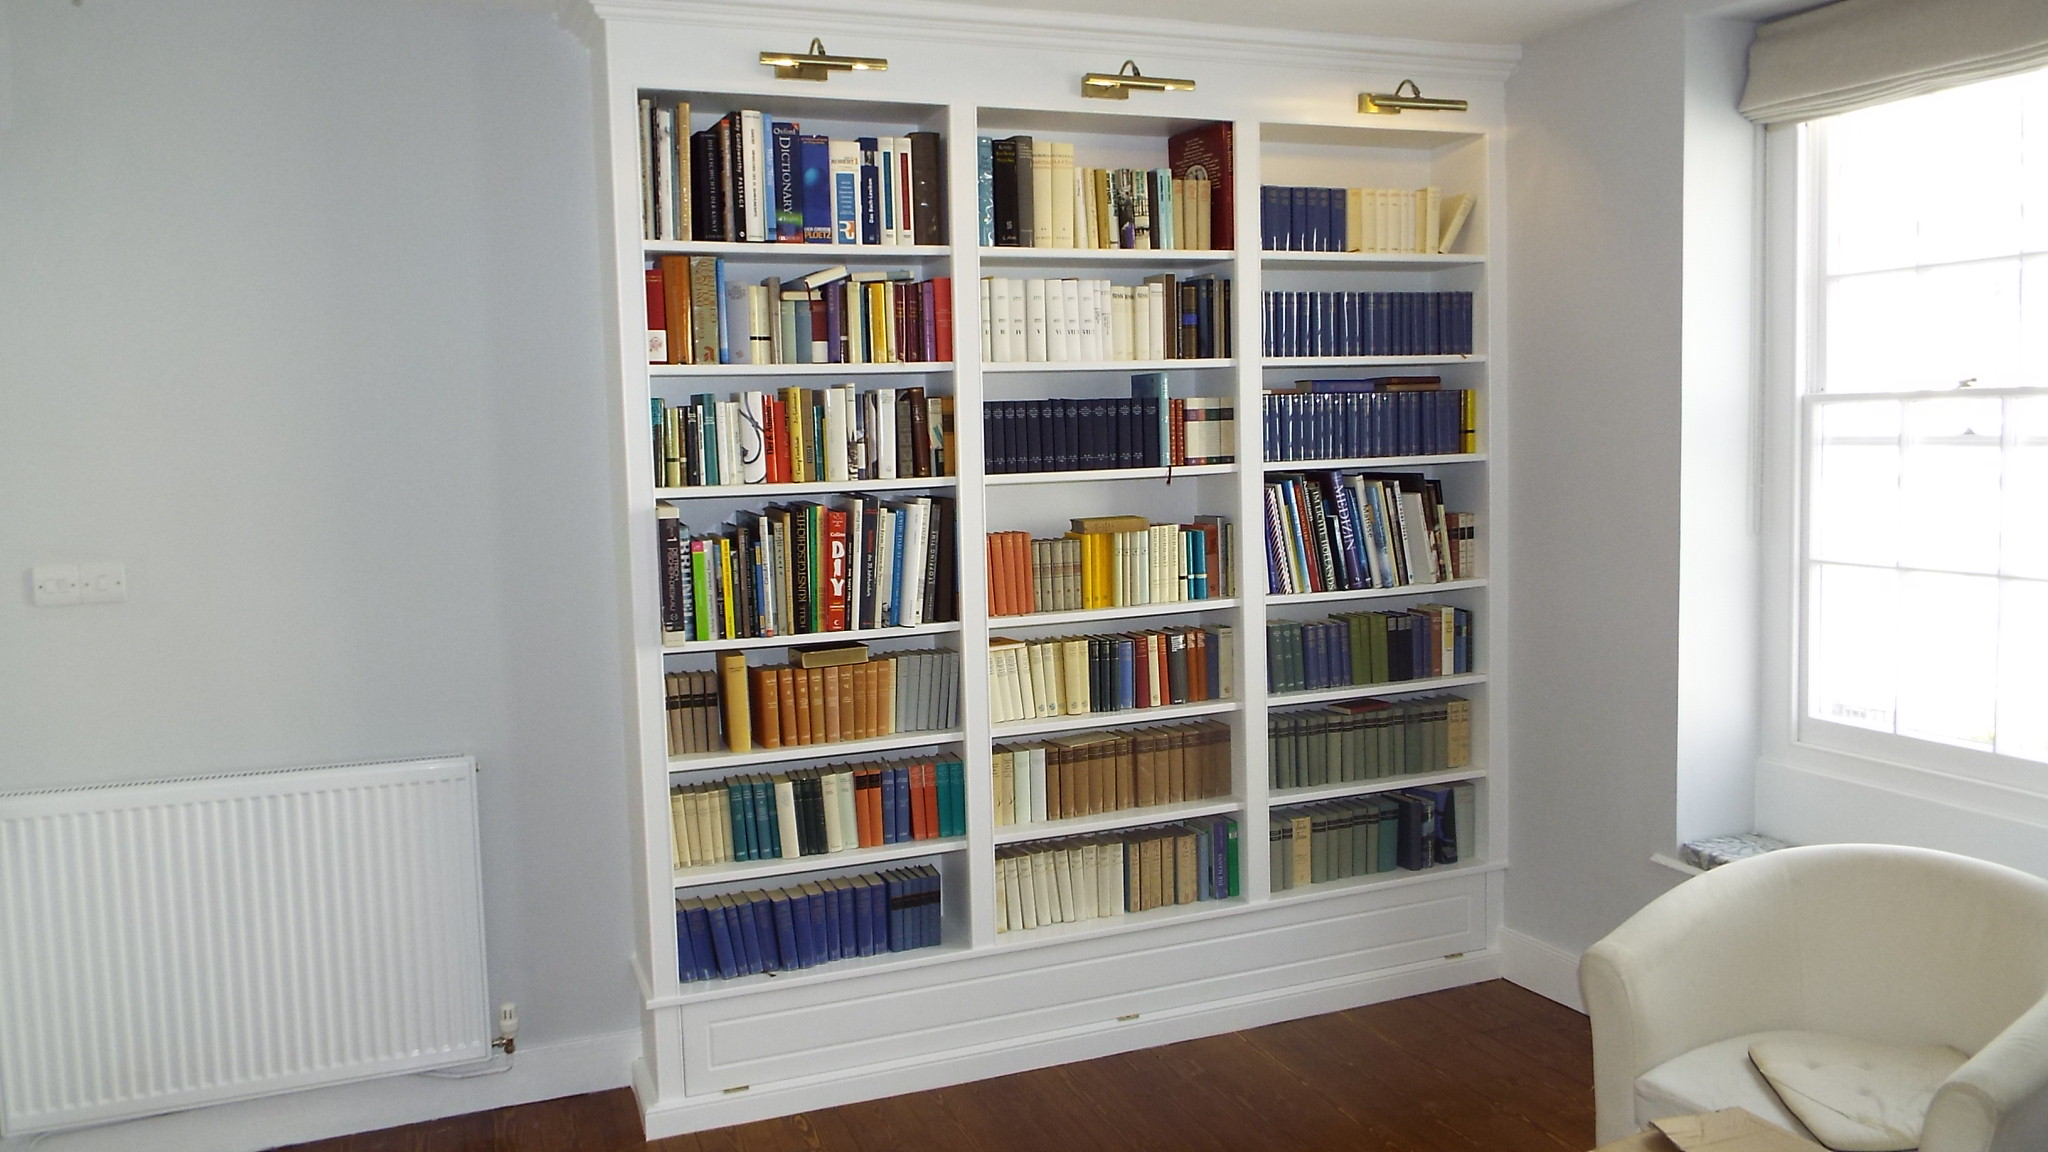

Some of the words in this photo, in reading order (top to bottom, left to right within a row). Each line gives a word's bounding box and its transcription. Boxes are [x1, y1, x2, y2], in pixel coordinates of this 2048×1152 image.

[773, 127, 796, 135] Oxford
[708, 152, 716, 194] GESCHICHTE
[778, 137, 793, 215] DICTIONARY
[804, 231, 832, 239] PLOETZ
[1334, 484, 1354, 551] MEDIZIN
[1362, 504, 1373, 538] Matisse
[796, 511, 807, 602] KUNSTGESCHICHTE
[830, 541, 845, 596] DIY
[928, 548, 936, 585] STOPPING
[1321, 539, 1336, 591] HOLLANDS
